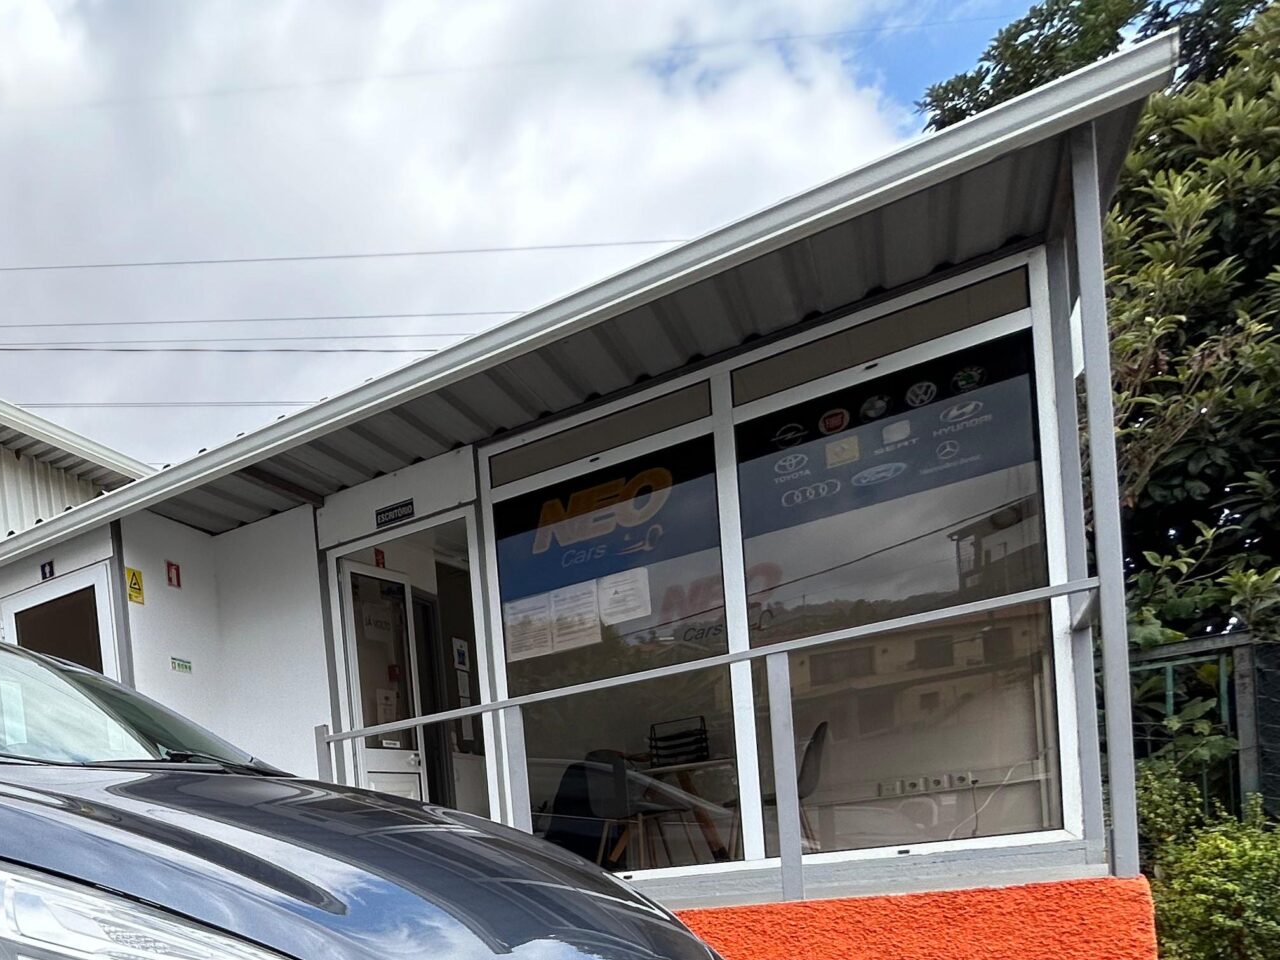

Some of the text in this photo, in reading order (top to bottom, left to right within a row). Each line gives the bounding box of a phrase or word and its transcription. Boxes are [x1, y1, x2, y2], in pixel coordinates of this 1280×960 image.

[873, 437, 920, 456] SEAT
[773, 468, 812, 485] TOYOTA
[532, 467, 672, 555] NEO
[561, 542, 608, 568] Cars
[682, 622, 723, 642] Cars
